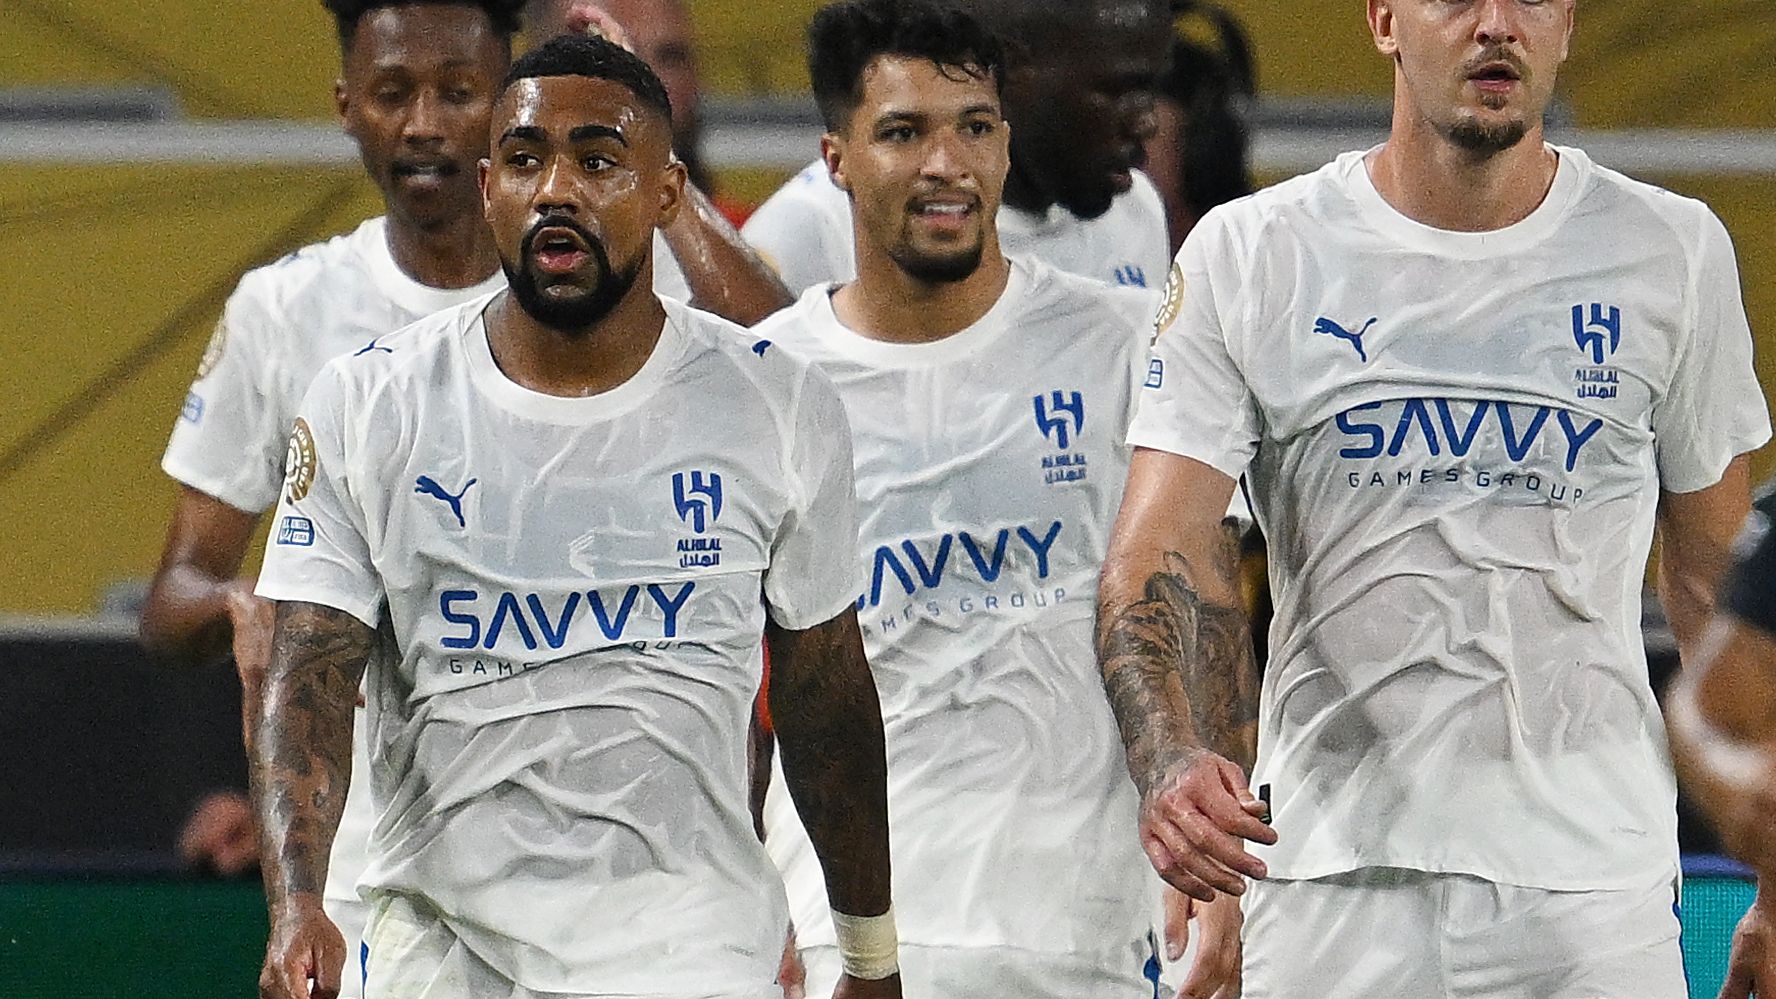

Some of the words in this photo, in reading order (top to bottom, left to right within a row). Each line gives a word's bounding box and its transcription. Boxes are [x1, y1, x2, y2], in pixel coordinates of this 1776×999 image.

[1336, 397, 1603, 472] SAVVY
[1348, 468, 1459, 488] GAMES
[1476, 471, 1583, 503] GROUP
[856, 521, 1063, 611] AVVY
[960, 587, 1067, 613] GROUP
[440, 581, 696, 650] SAVVY
